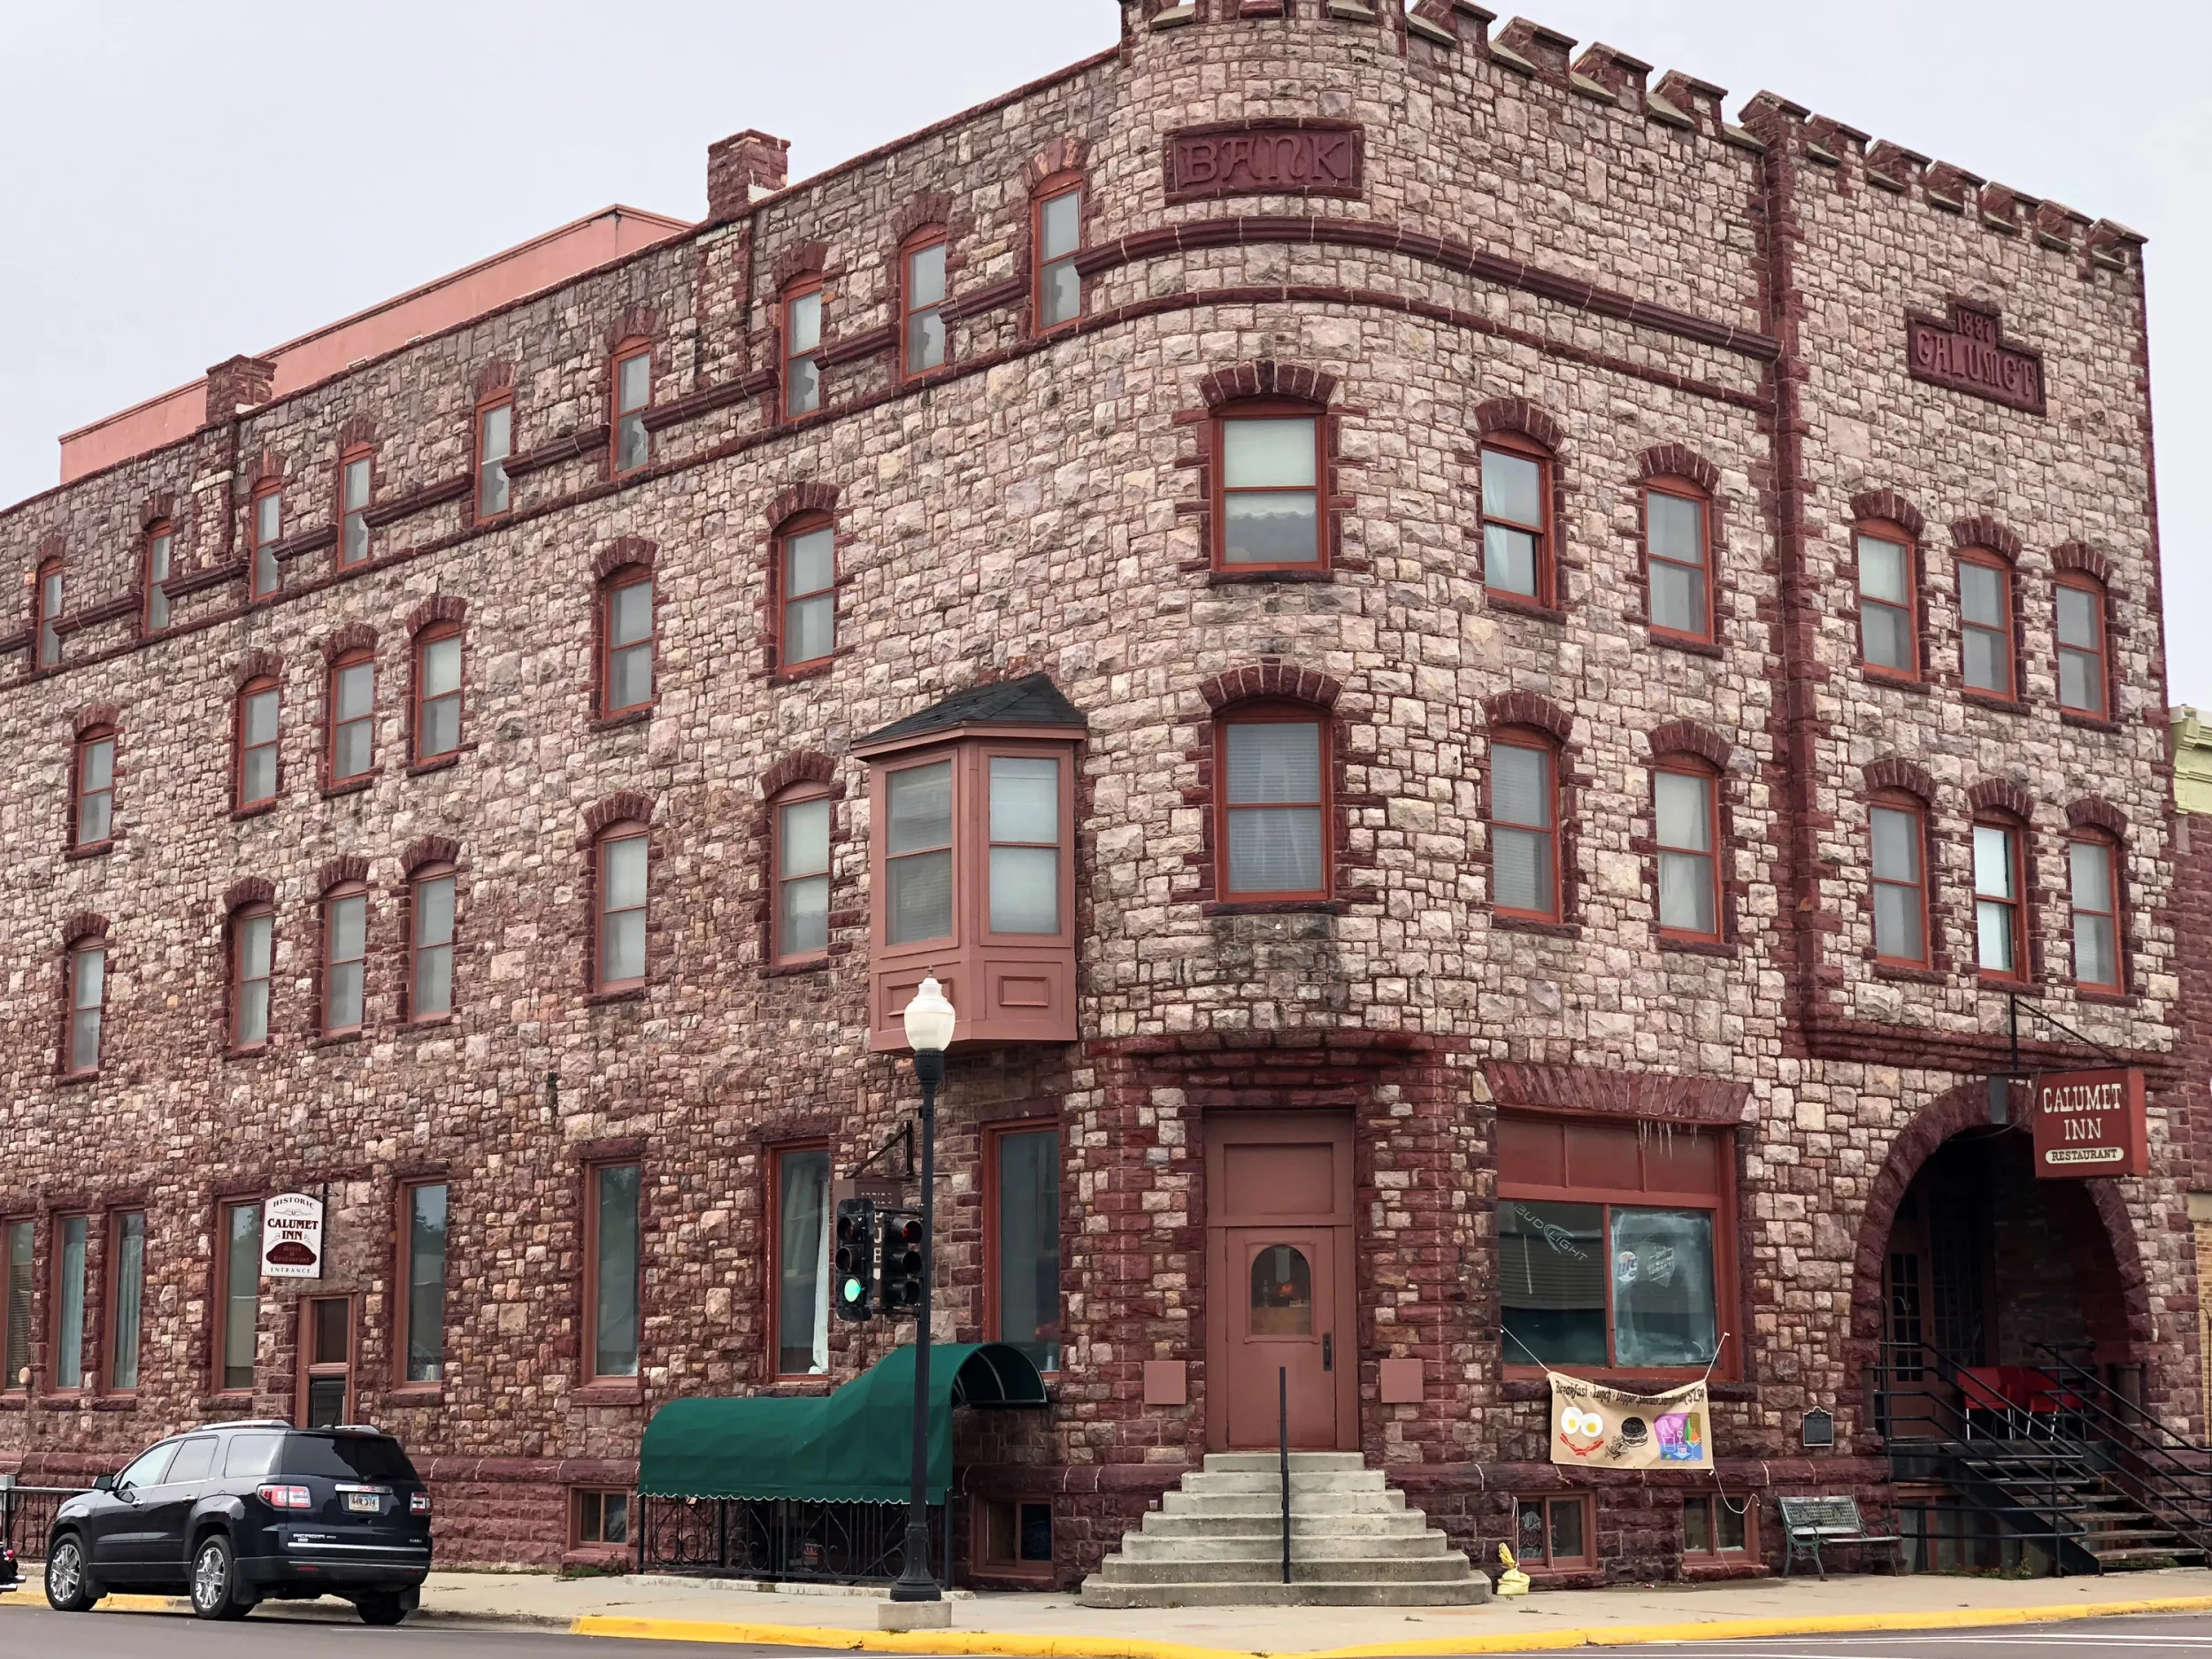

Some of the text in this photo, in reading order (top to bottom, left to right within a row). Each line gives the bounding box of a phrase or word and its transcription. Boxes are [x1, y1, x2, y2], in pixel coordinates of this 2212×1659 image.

[1180, 134, 1350, 187] BANK
[1956, 310, 1994, 343] 1887
[1916, 329, 2036, 397] CALUMET
[2043, 1083, 2122, 1113] CALUMET
[2063, 1118, 2102, 1141] INN
[2051, 1148, 2117, 1162] RESTAURANT
[273, 1197, 314, 1209] HISTORIC
[267, 1218, 319, 1230] CALUMET
[281, 1230, 303, 1240] INN
[1514, 1204, 1588, 1261] BUD LIGHT
[1650, 1262, 1671, 1275] DRAFT
[1555, 1380, 1588, 1399] Breakfast
[1593, 1386, 1611, 1402] Lunch
